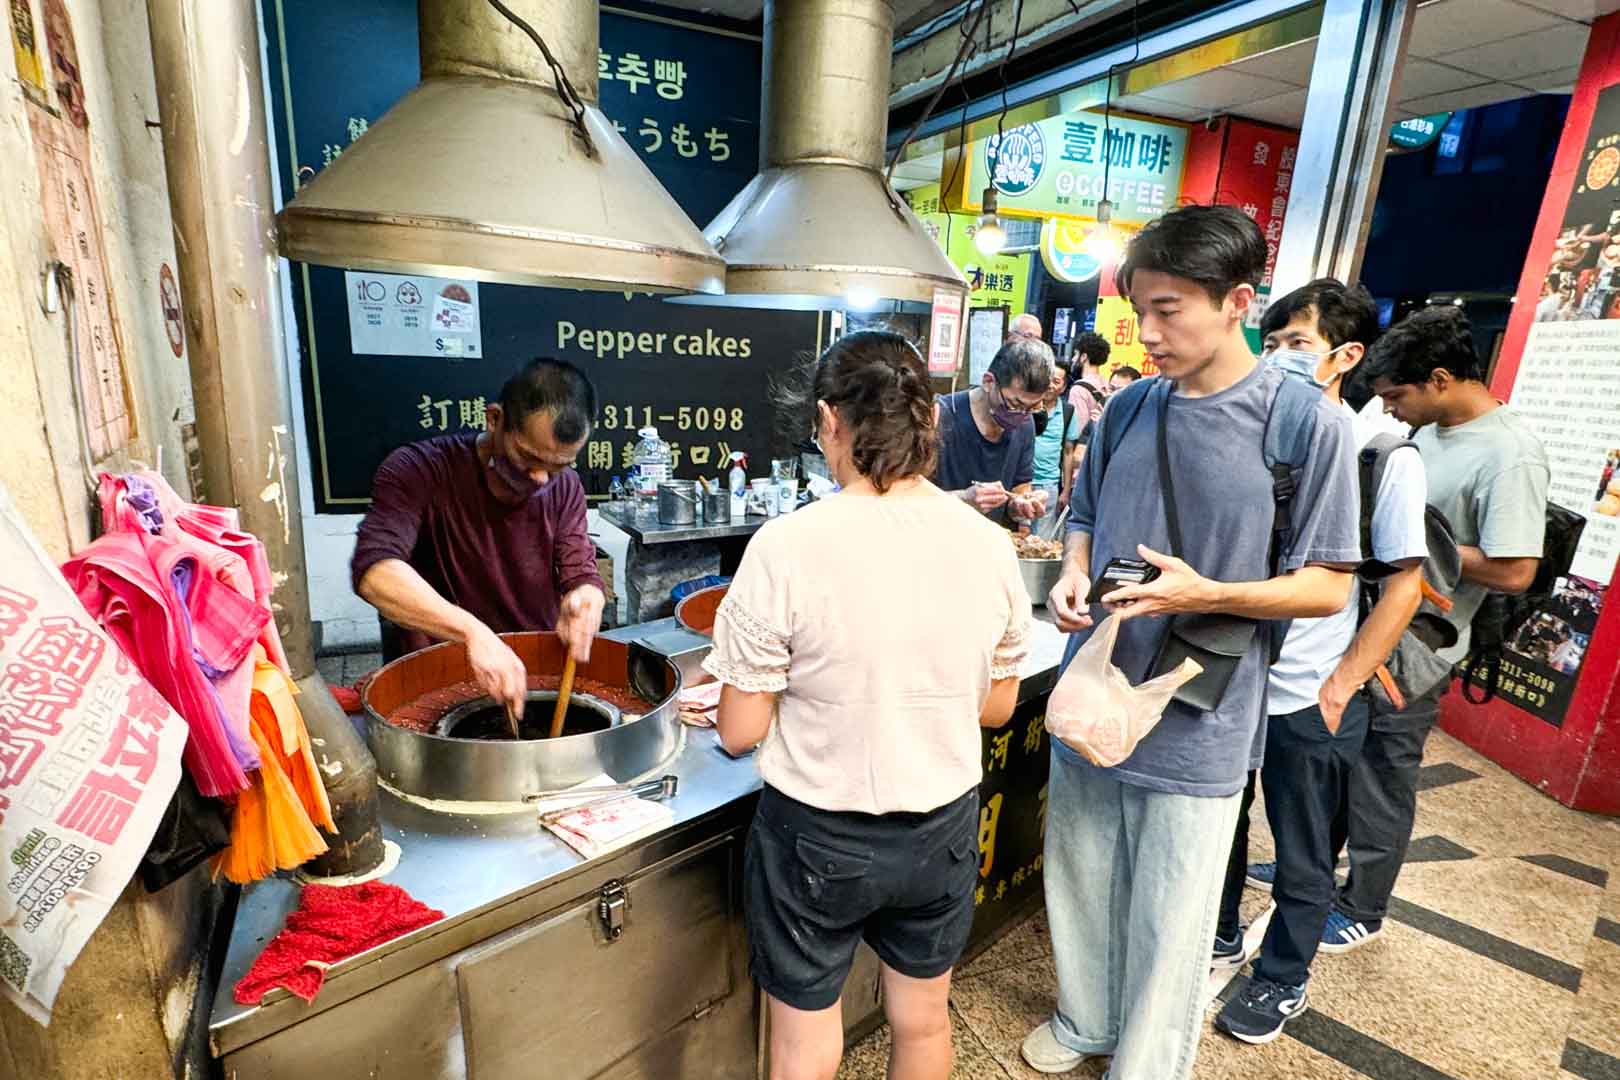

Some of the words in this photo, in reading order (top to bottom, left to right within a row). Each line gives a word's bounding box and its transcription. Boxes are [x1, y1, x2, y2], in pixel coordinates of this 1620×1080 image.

[1060, 121, 1172, 174] 壹咖啡
[557, 321, 667, 359] Pepper
[672, 328, 752, 359] cakes
[416, 394, 488, 432] 訂購
[594, 404, 744, 431] 311-5098
